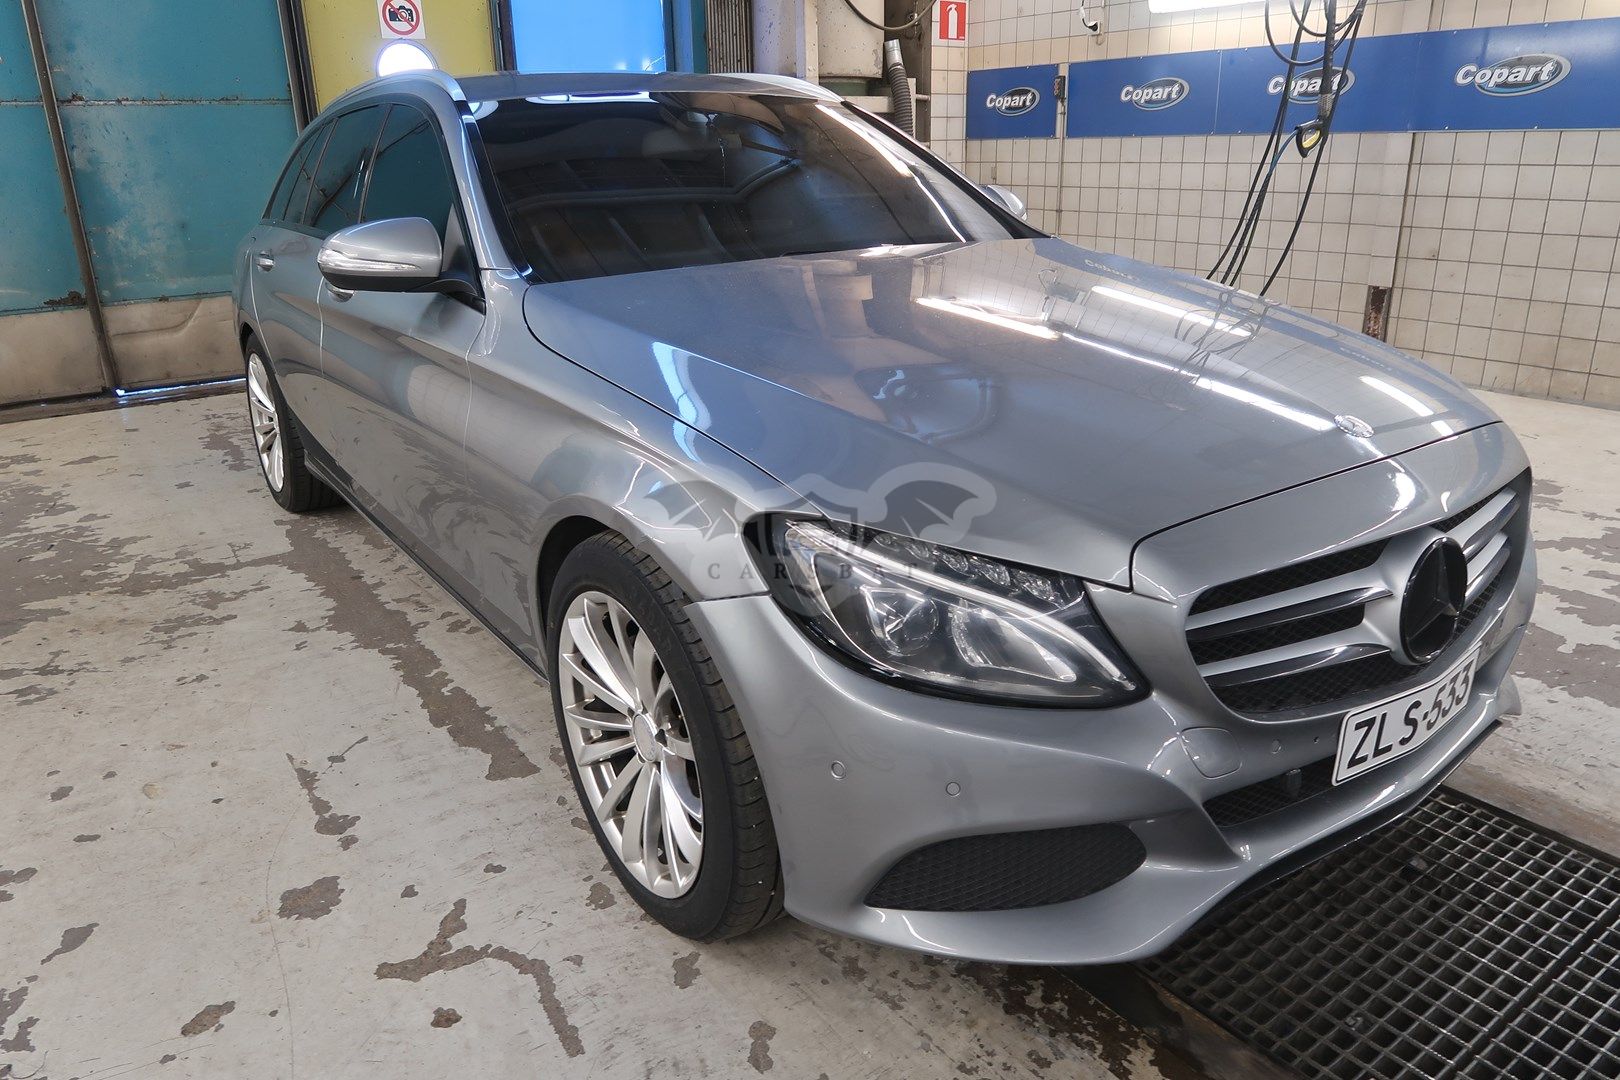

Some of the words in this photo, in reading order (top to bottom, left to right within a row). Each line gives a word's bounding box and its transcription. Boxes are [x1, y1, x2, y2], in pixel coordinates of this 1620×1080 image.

[1455, 60, 1556, 88] Copart
[986, 92, 1033, 110] Copart
[1120, 81, 1181, 104] Copart
